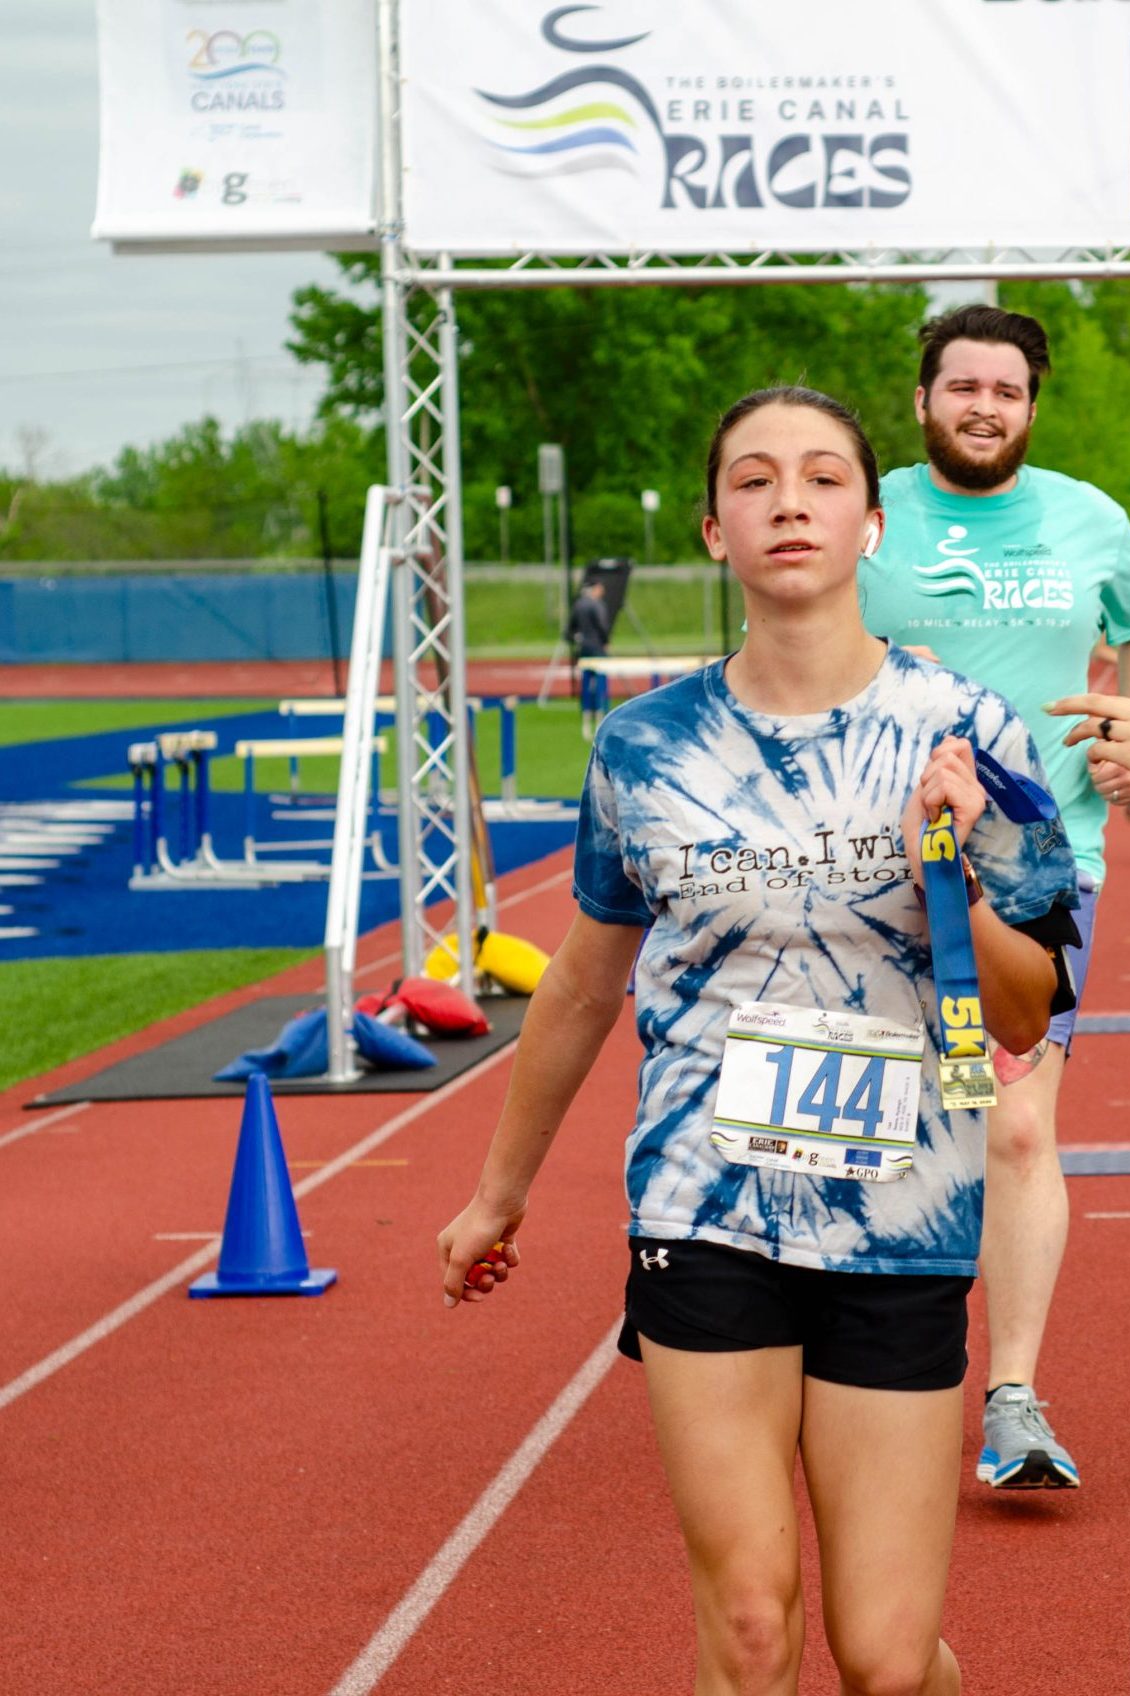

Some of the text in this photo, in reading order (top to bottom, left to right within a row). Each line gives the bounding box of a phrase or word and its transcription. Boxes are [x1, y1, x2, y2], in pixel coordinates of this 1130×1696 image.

[667, 75, 896, 88] THE BOILERMAKER'S
[190, 91, 285, 112] CANALS
[668, 98, 910, 120] ERIE CANAL
[661, 134, 912, 209] RACES
[984, 567, 1071, 578] ERIE CANAL
[983, 577, 1074, 610] RACES
[924, 618, 950, 628] MILE
[963, 617, 999, 628] RELAY
[679, 844, 695, 880] I
[680, 876, 750, 900] End
[766, 870, 814, 889] of
[737, 1013, 786, 1027] Wolfspeed
[941, 995, 985, 1057] 5K
[766, 1044, 886, 1137] 144
[856, 1166, 879, 1179] GPO
